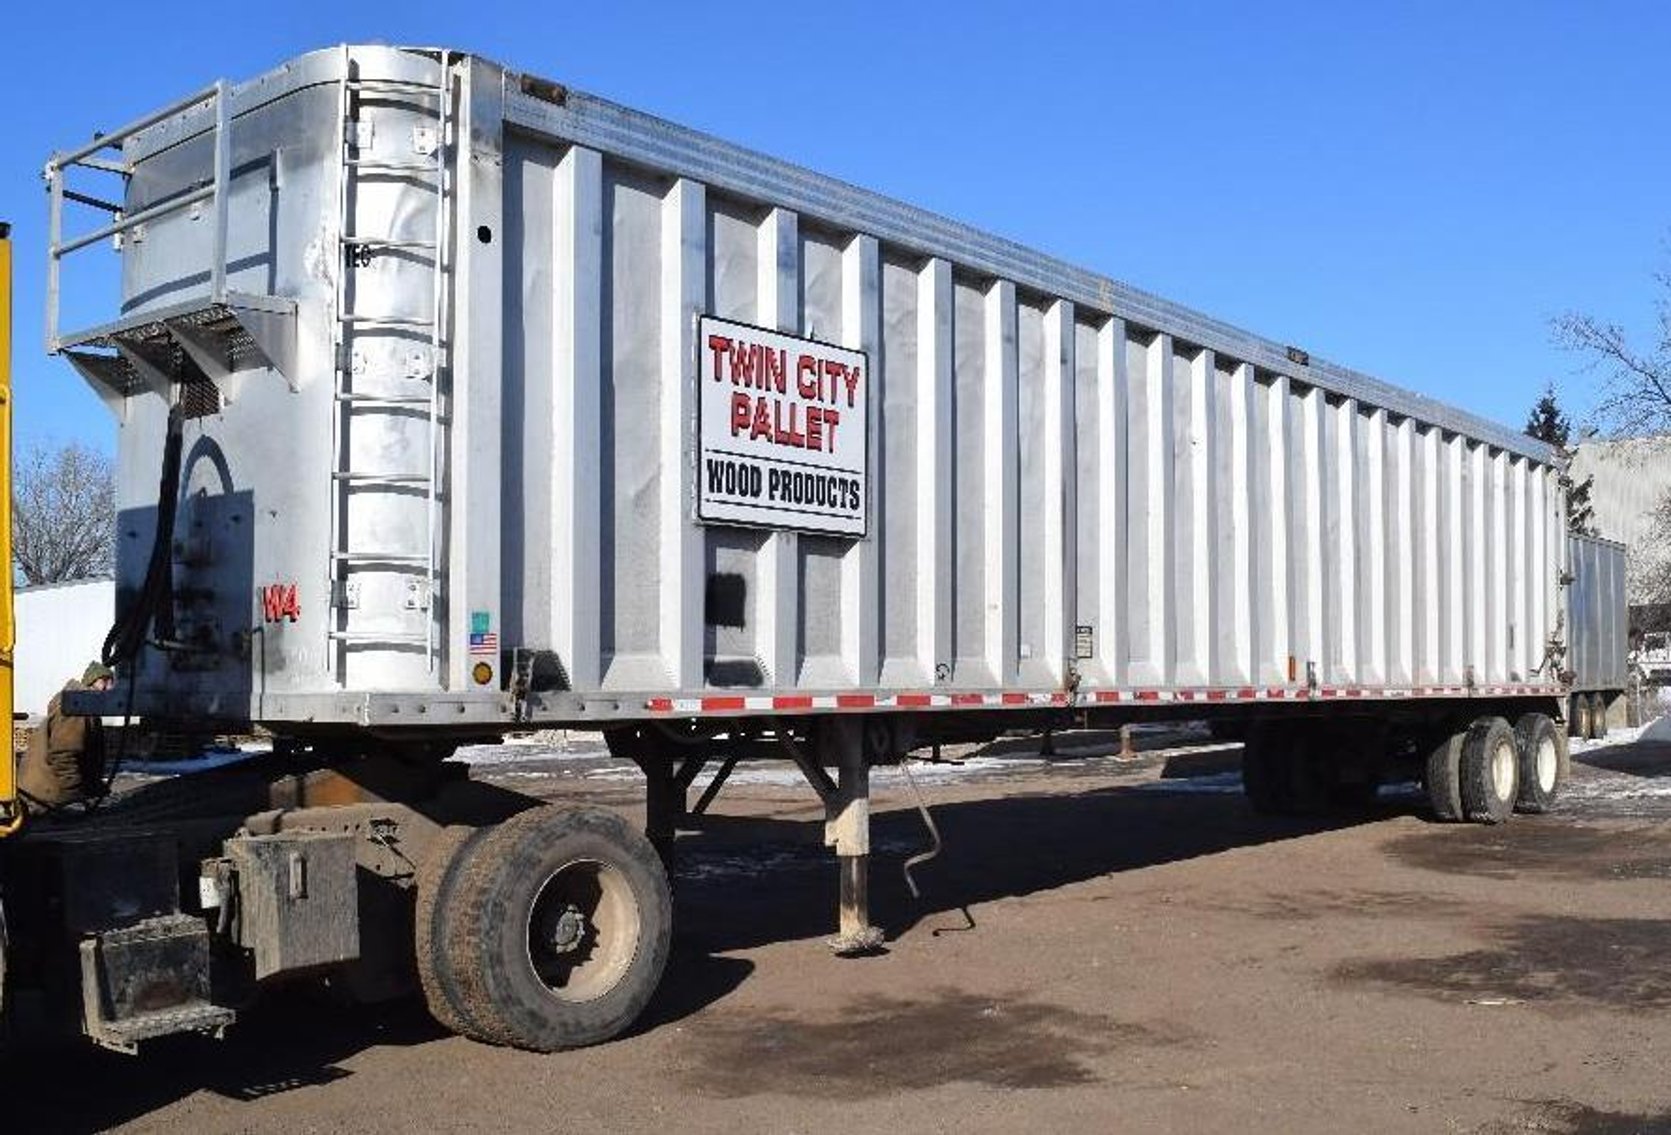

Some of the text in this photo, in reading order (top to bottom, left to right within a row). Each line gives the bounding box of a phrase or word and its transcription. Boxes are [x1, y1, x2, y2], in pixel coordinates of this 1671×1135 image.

[708, 334, 861, 408] TWIN CITY
[731, 390, 840, 454] PALLET
[706, 458, 861, 511] WOOD PRODUCTS
[262, 584, 300, 623] W4
